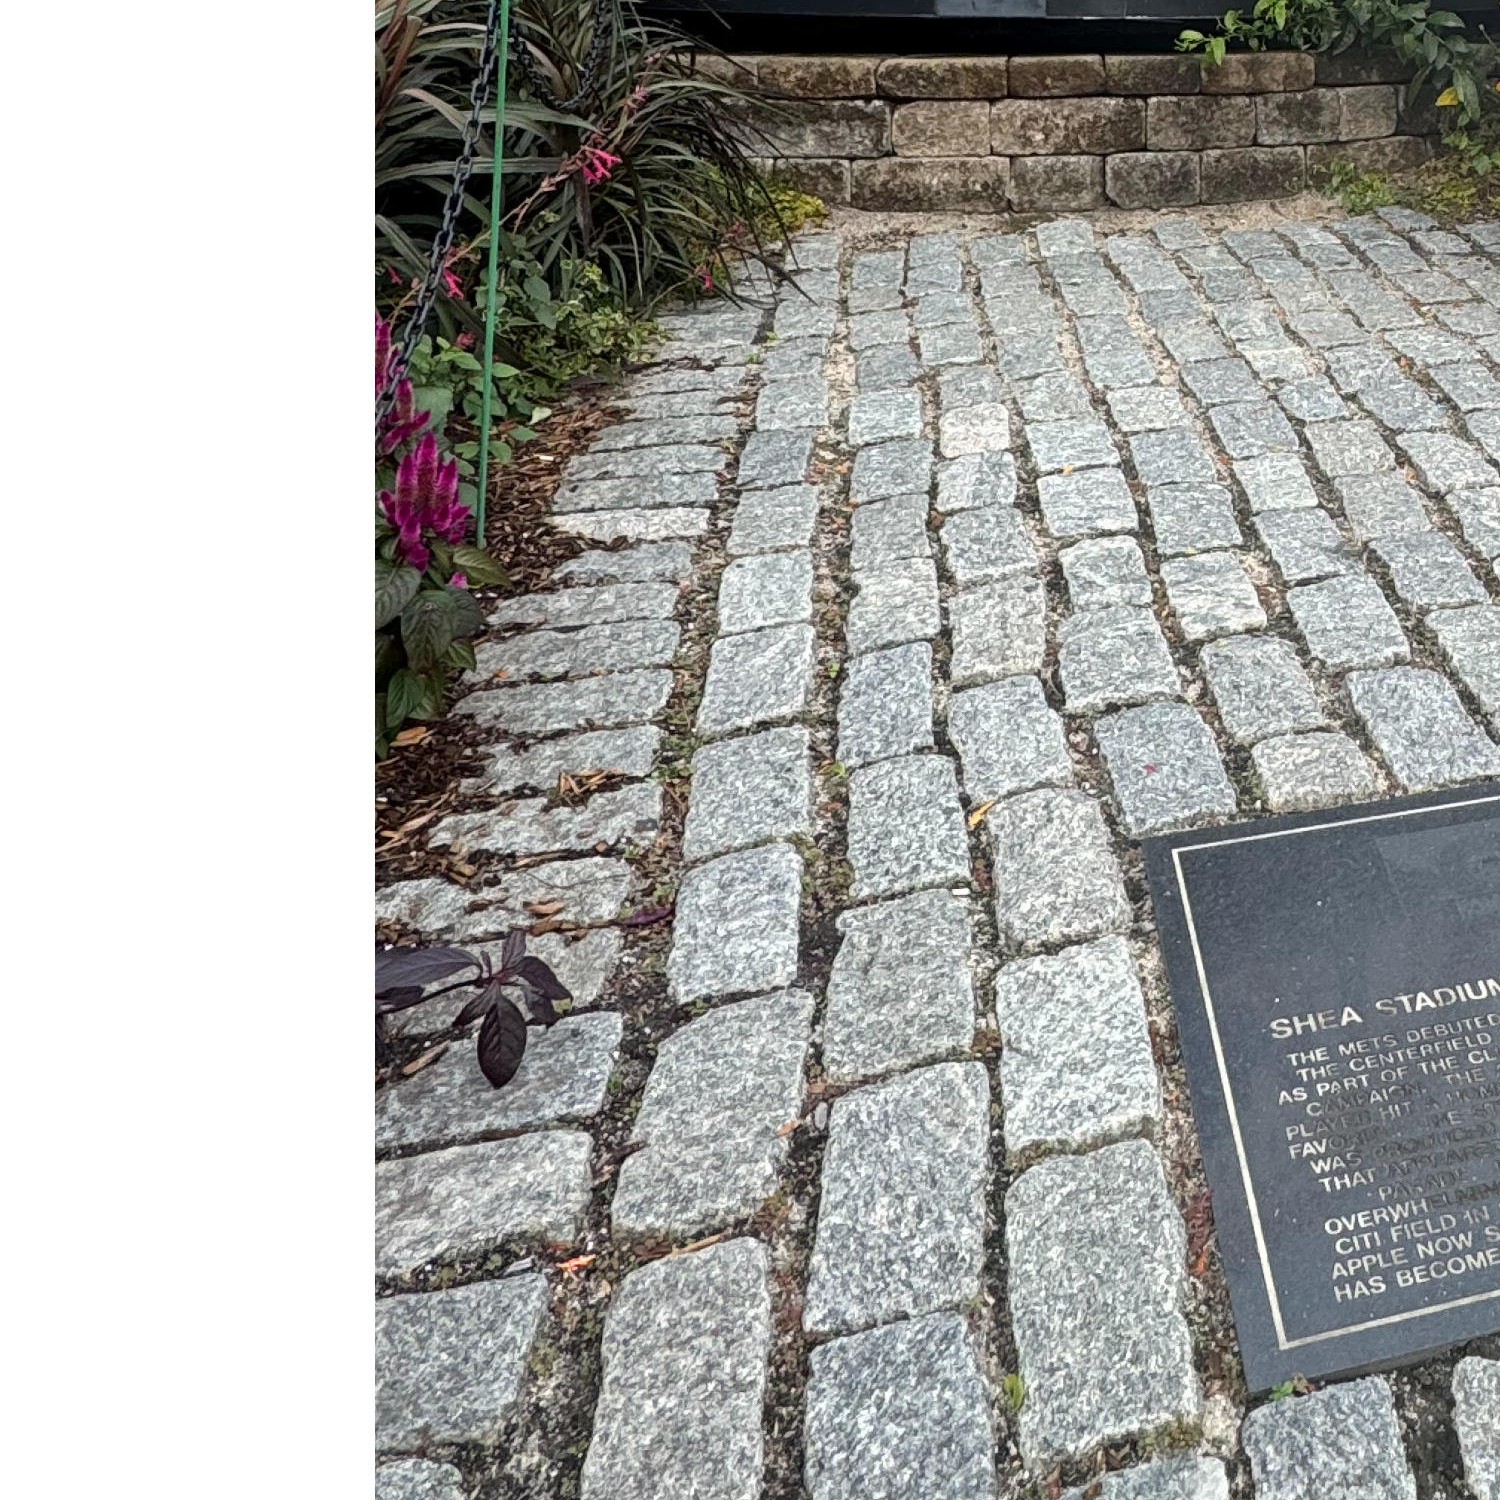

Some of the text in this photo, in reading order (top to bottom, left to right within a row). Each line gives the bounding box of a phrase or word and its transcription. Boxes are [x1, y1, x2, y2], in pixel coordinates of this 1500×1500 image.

[1270, 1005, 1361, 1038] SHEA
[1287, 1047, 1328, 1067] THE
[1338, 1033, 1396, 1056] METS
[1296, 1061, 1339, 1082] THE
[1349, 1031, 1492, 1071] CENTERFIELD
[1277, 1086, 1306, 1105] AS
[1316, 1073, 1371, 1096] PART
[1380, 1065, 1410, 1083] OF
[1419, 1055, 1459, 1075] THE
[1444, 1067, 1485, 1088] THE
[1380, 1101, 1413, 1120] HIT
[1289, 1122, 1400, 1159] FAVORIT.
[1422, 1109, 1460, 1129] HE
[1311, 1151, 1361, 1175] WAS
[1319, 1167, 1377, 1193] THAT
[1334, 1230, 1380, 1256] CITI
[1390, 1212, 1457, 1243] FIELD
[1465, 1205, 1490, 1225] IN
[1330, 1246, 1406, 1280] APPLE
[1416, 1230, 1474, 1259] NOW
[1334, 1275, 1386, 1303] HAS
